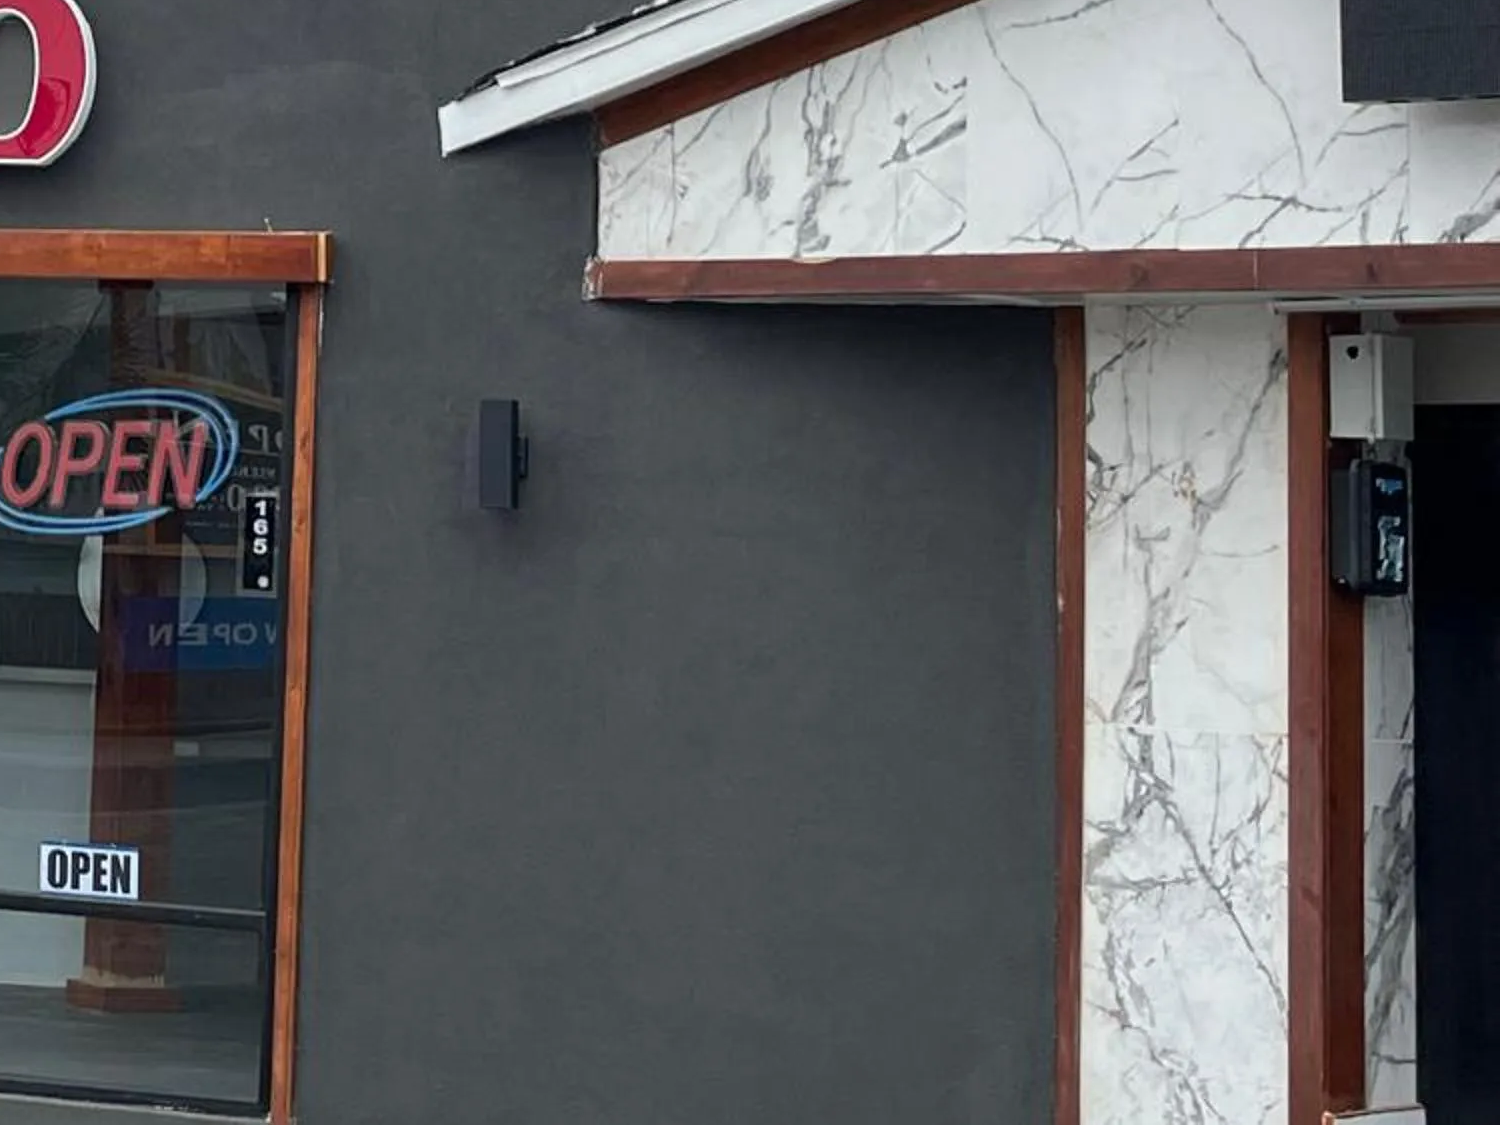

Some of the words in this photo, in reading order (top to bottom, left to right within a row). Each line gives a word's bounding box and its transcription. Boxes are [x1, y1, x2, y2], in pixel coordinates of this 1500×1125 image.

[1, 418, 209, 509] OPEN
[252, 498, 269, 555] 165
[46, 848, 132, 895] OPEN
